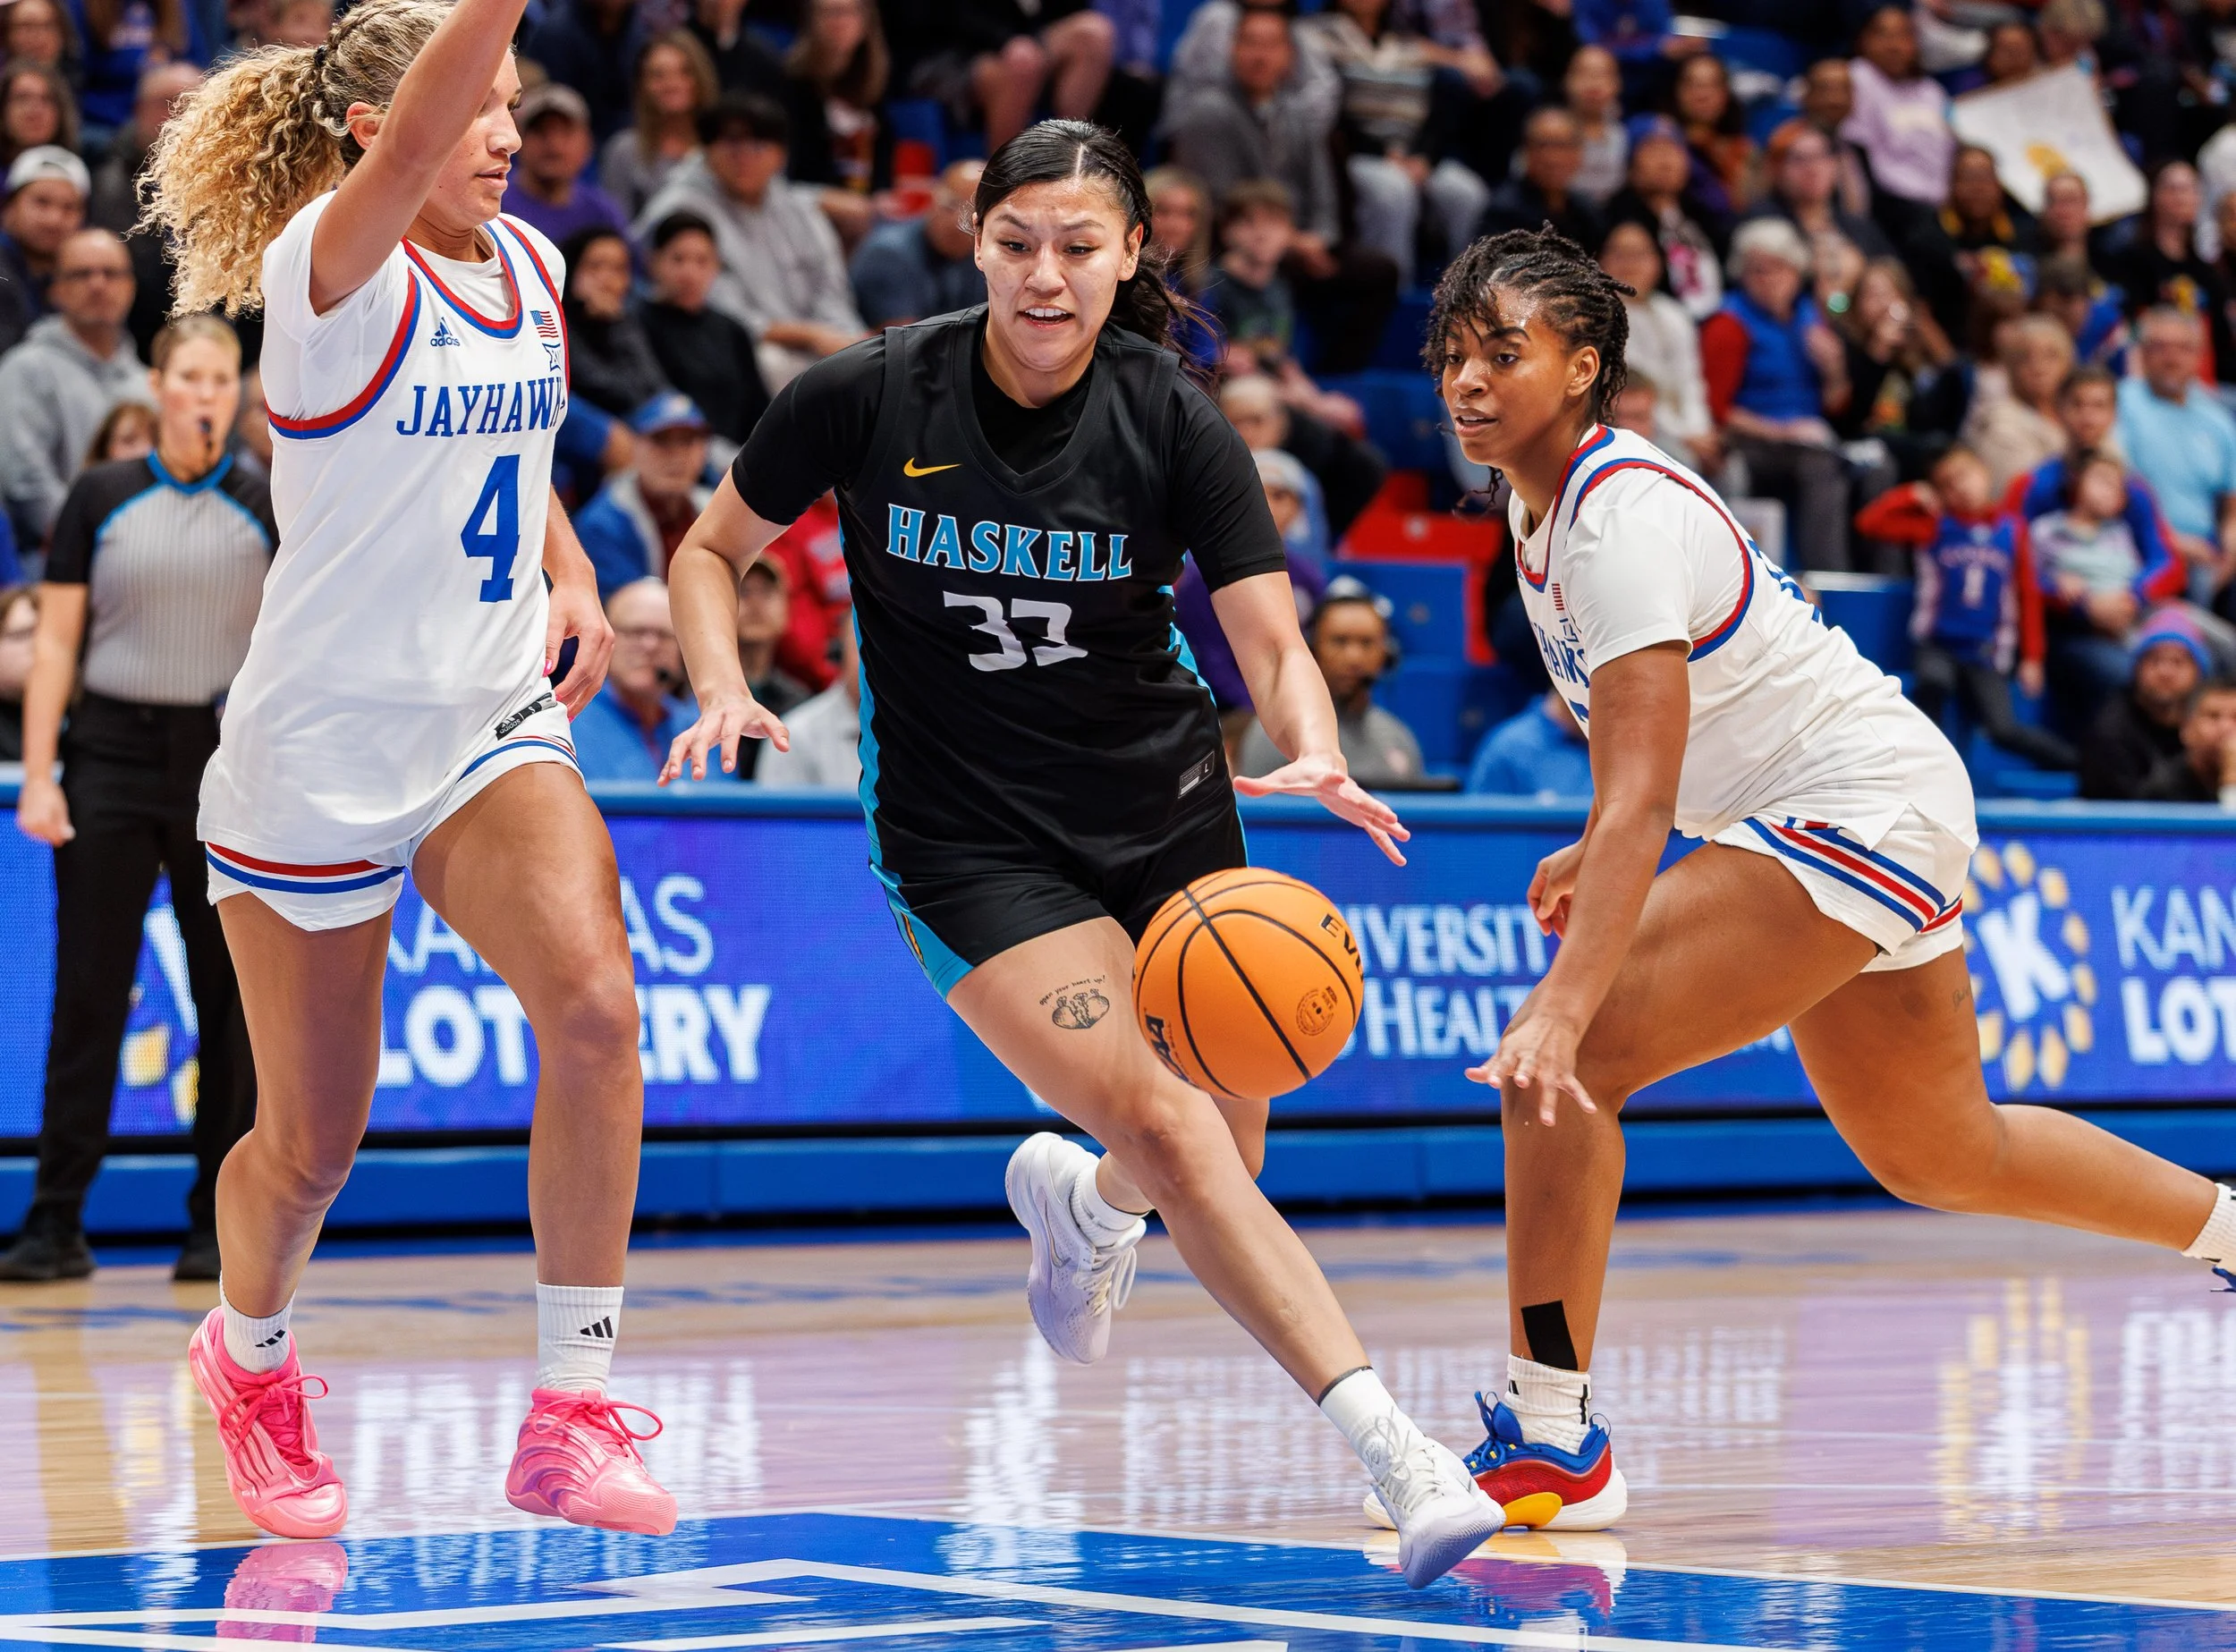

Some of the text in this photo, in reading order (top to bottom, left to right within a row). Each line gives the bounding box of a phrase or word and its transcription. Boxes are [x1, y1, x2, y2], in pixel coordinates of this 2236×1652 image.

[460, 453, 521, 603] 4
[886, 503, 1132, 581] HASKELL
[943, 590, 1088, 672] 33
[499, 718, 521, 734] adidas
[1321, 913, 1362, 977] EV
[1343, 905, 1551, 976] IVERSIT
[1978, 894, 2069, 1020] K
[376, 985, 771, 1086] OTRY
[1365, 978, 1537, 1057] HEAL
